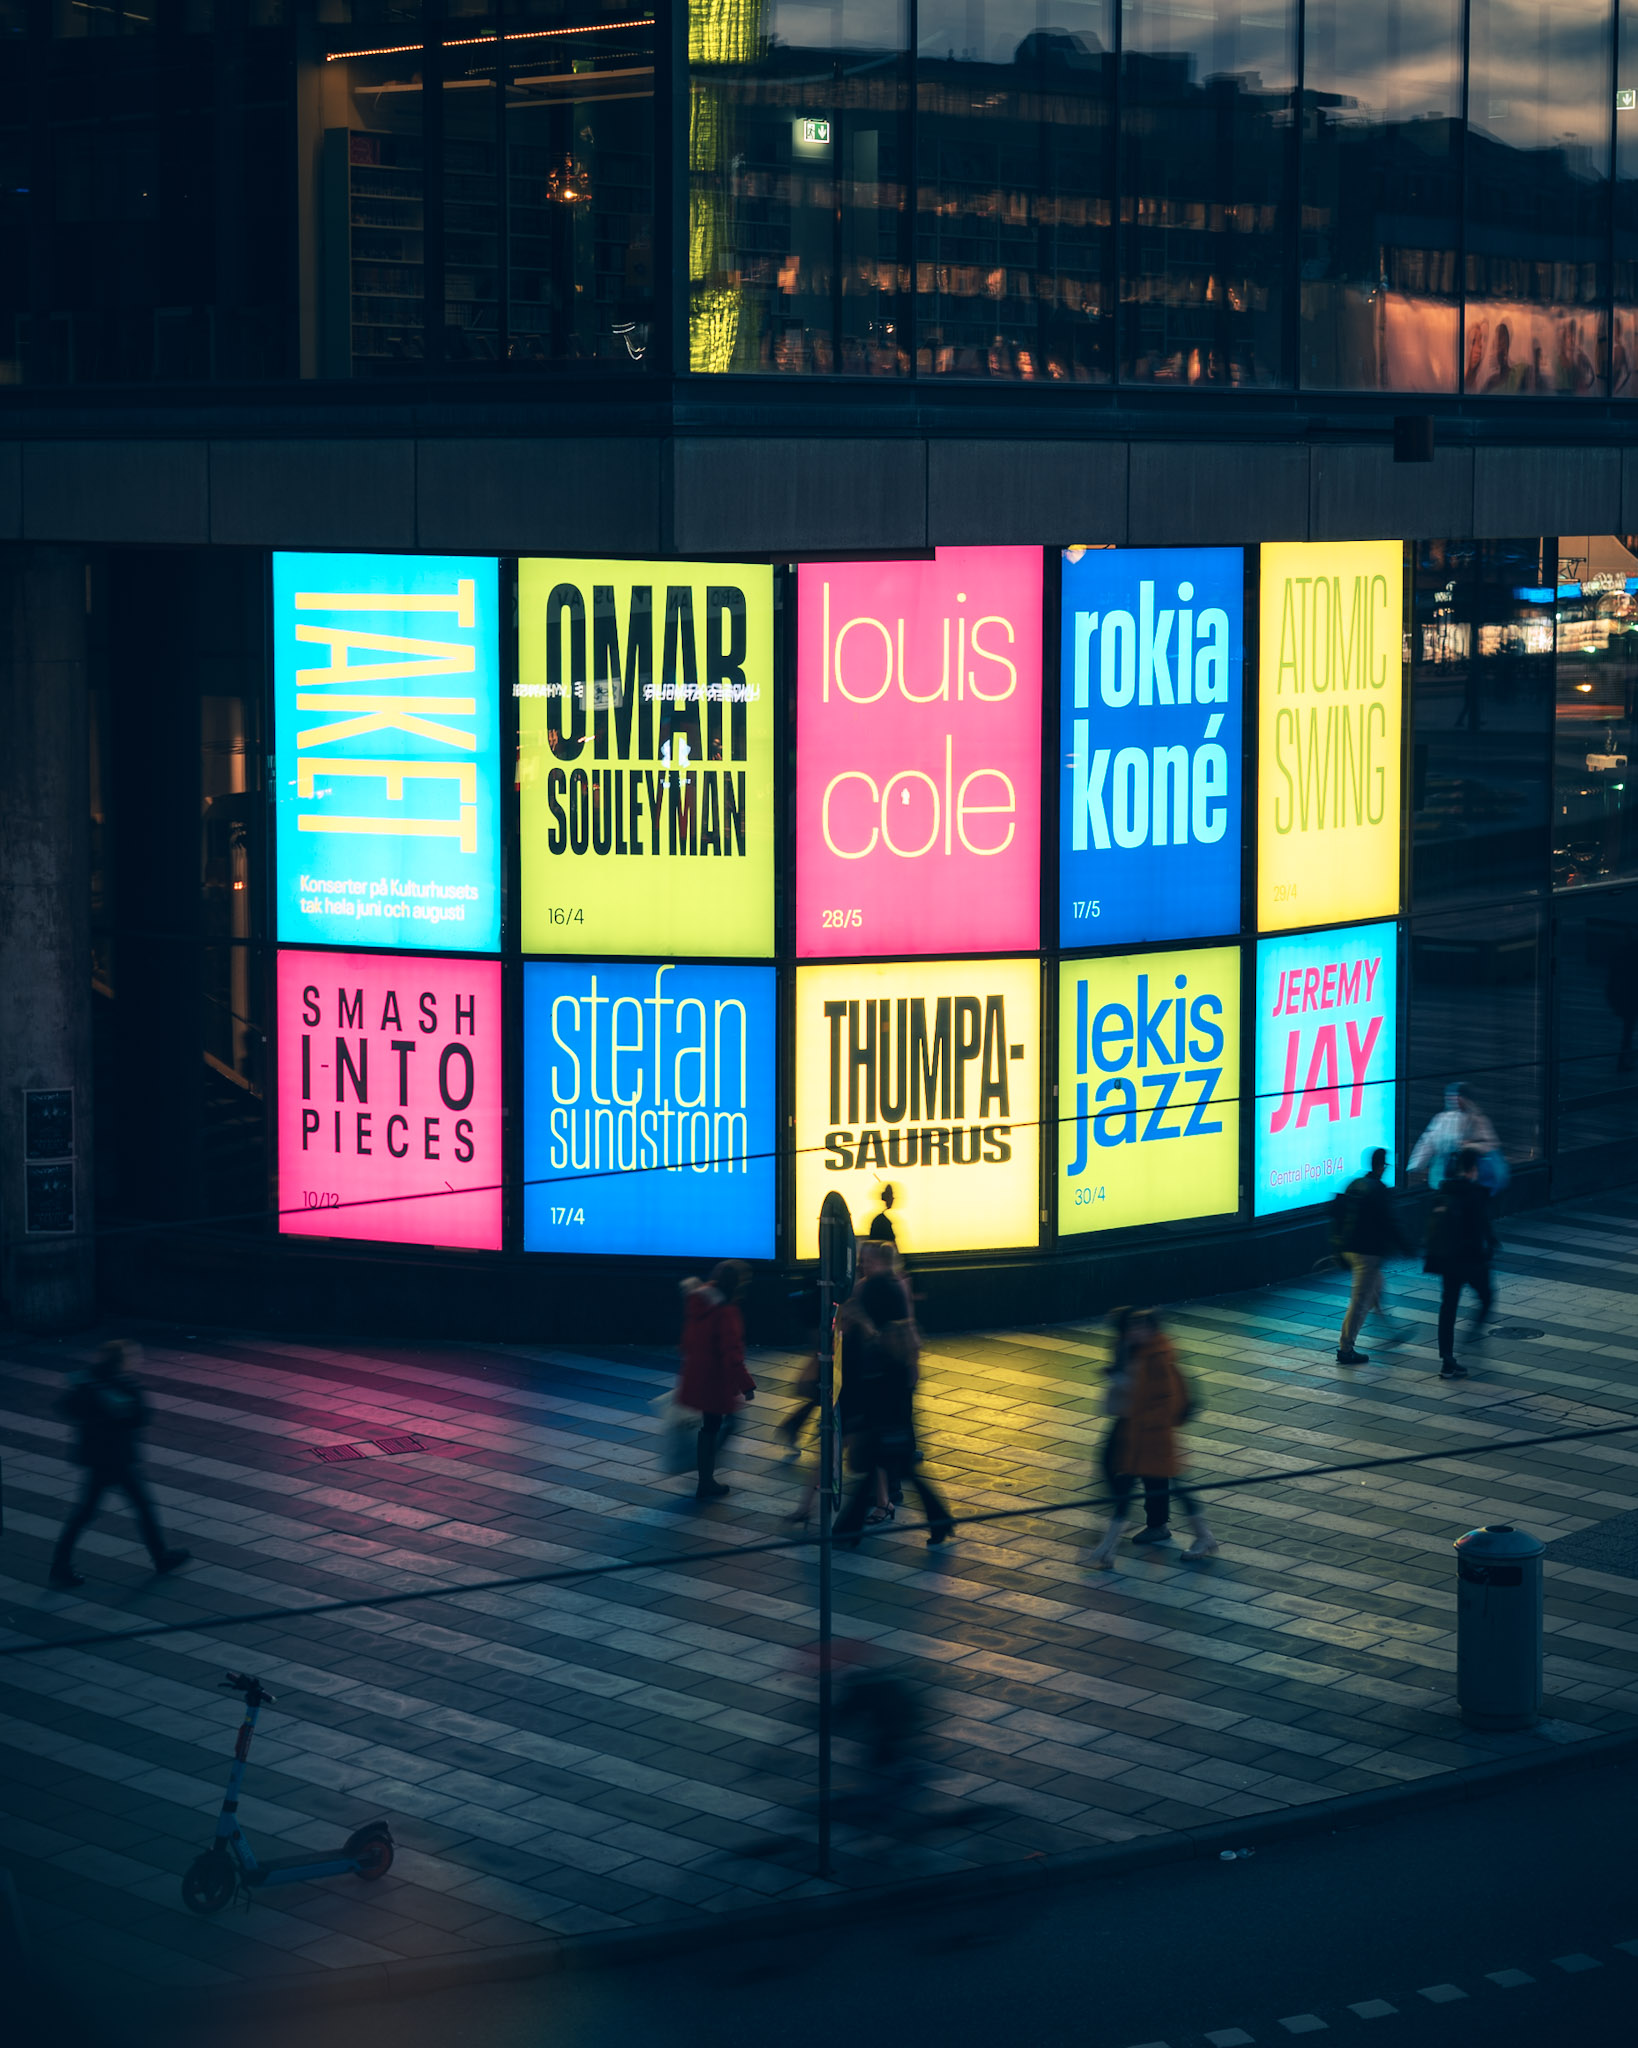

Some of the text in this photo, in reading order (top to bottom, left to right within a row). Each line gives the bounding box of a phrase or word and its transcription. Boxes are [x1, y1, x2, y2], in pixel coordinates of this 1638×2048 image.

[546, 583, 747, 761] OMAR
[823, 582, 1017, 704] louis
[1074, 580, 1230, 708] rokia
[1277, 574, 1387, 695] ATOMIC
[295, 579, 477, 854] TAKET
[822, 734, 1016, 860] cole
[1072, 713, 1228, 851] koné
[1275, 702, 1386, 835] SWING
[548, 768, 747, 857] SOULEYMAN
[300, 875, 479, 900] Konserter på Kulturhusets
[300, 897, 465, 924] tak hela juni och augusti
[548, 908, 584, 925] 16/4
[822, 910, 862, 928] 28/5
[1073, 901, 1100, 918] 17/5
[1274, 884, 1297, 902] 29/4
[303, 985, 475, 1035] SMASH
[1076, 974, 1224, 1074] lekis
[1272, 957, 1381, 1017] JEREMY
[551, 964, 747, 1108] stefan
[824, 994, 1025, 1126] THUMPA-
[1269, 1016, 1384, 1134] JAY
[302, 1108, 474, 1162] PIECES
[550, 1091, 748, 1174] sundstrom
[825, 1125, 1012, 1171] SAURUS
[1067, 1067, 1224, 1177] jazz
[303, 1191, 339, 1209] 10/12
[1074, 1186, 1106, 1205] 30/4
[1270, 1157, 1344, 1187] Central Pop 18/4
[551, 1207, 585, 1225] 17/4
